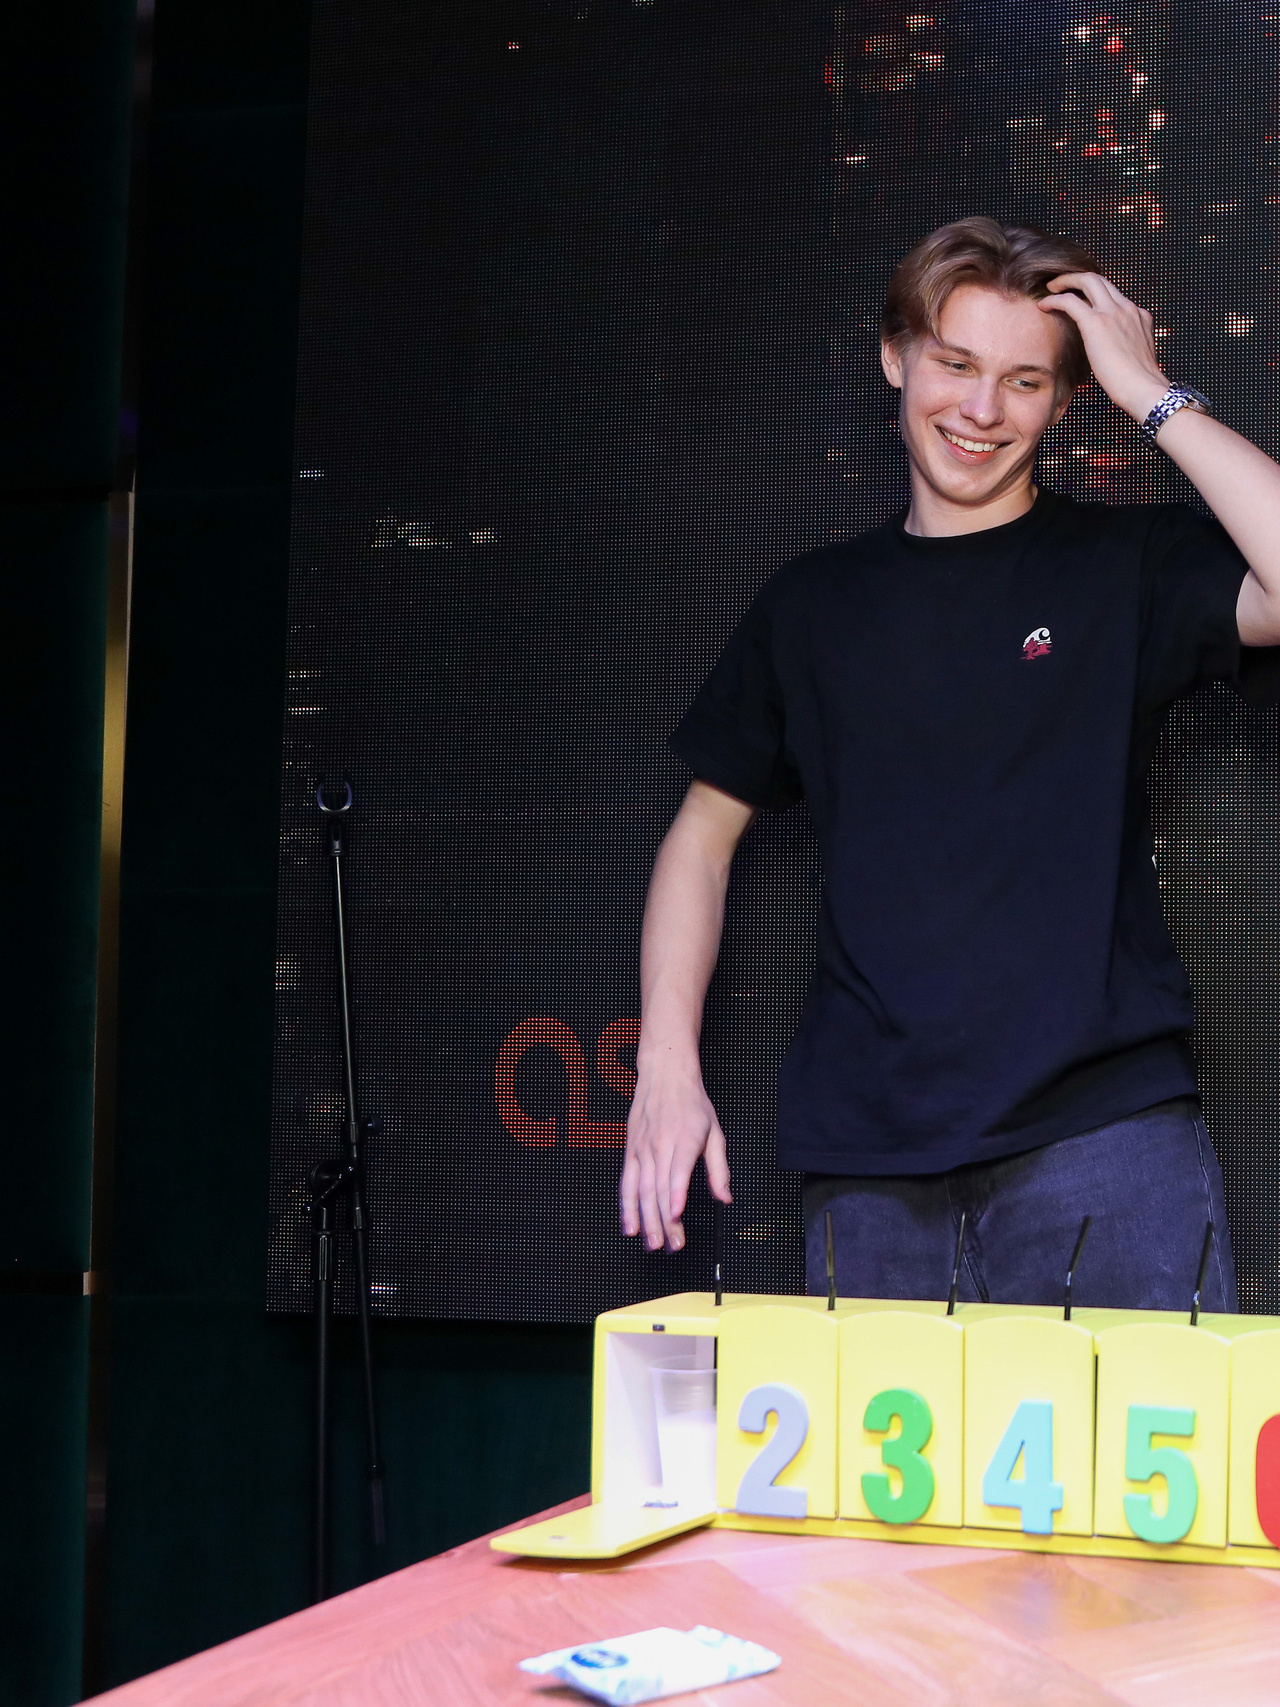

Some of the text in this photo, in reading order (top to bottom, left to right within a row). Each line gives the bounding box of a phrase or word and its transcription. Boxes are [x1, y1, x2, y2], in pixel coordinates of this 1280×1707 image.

[736, 1383, 808, 1519] 2
[861, 1387, 935, 1524] 3
[982, 1400, 1064, 1535] 4
[1123, 1404, 1198, 1544] 5
